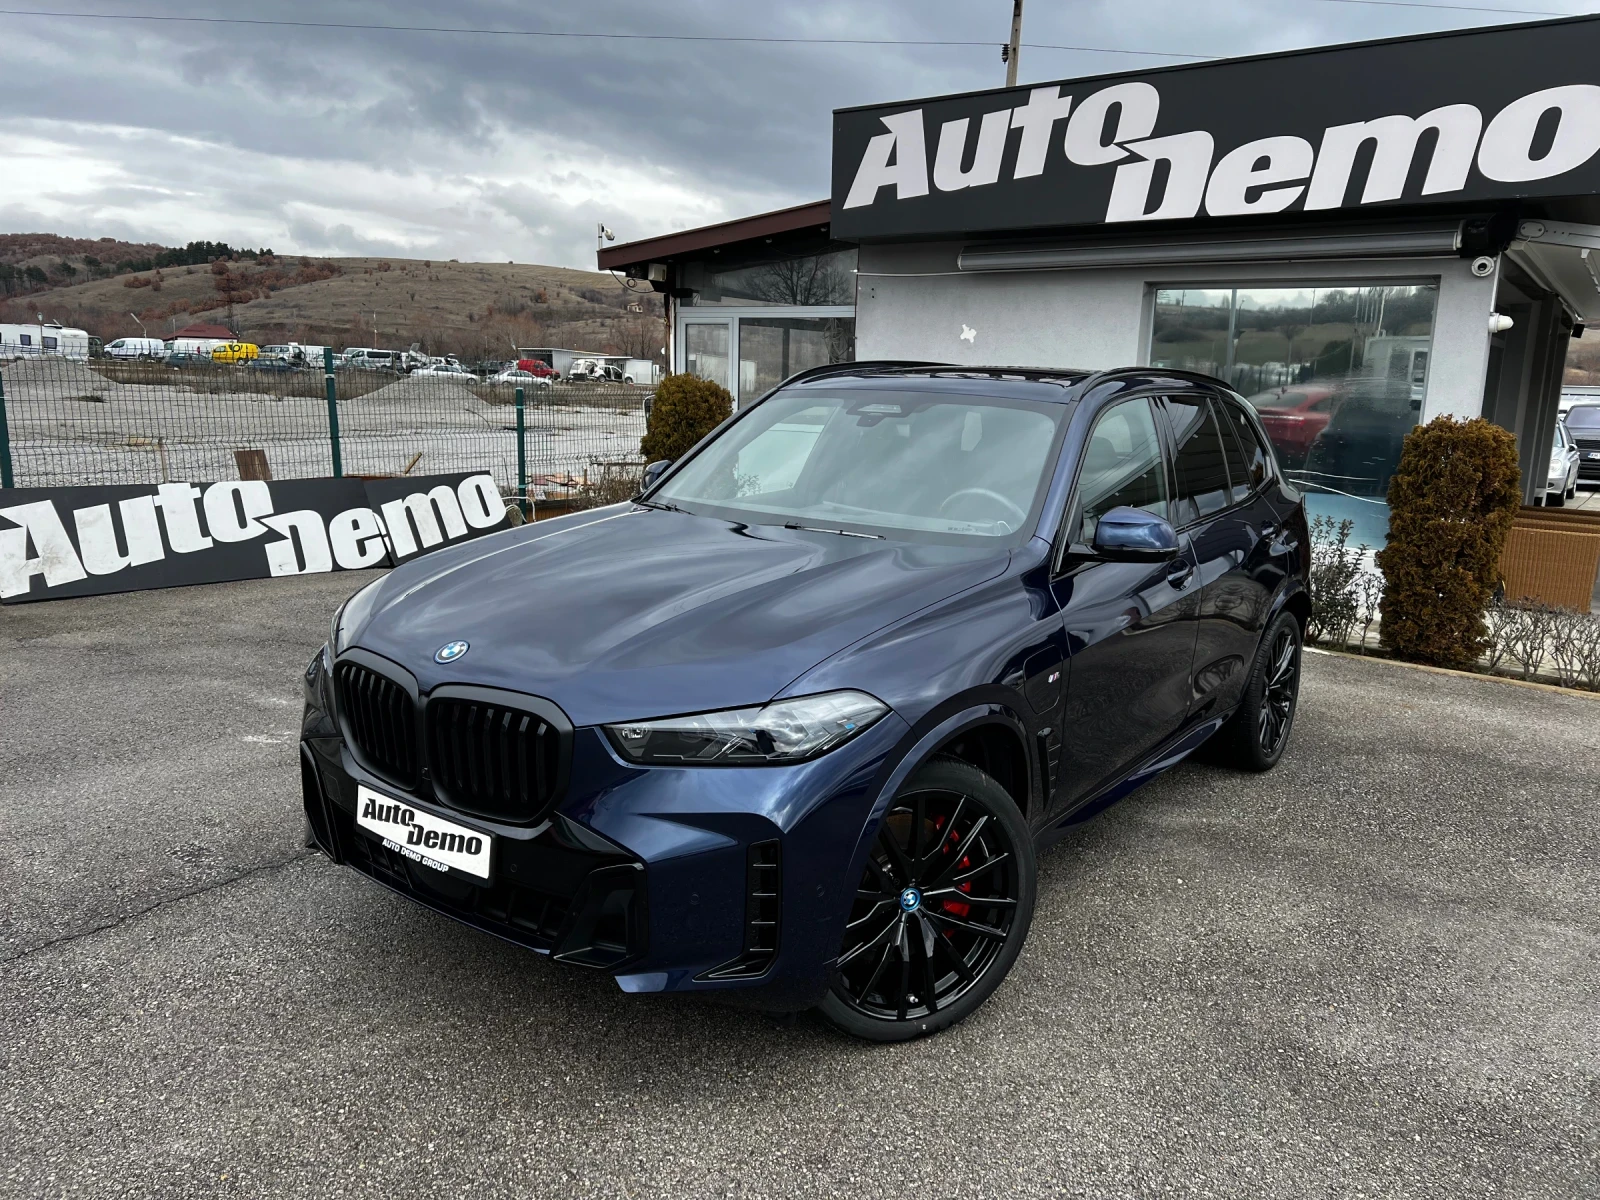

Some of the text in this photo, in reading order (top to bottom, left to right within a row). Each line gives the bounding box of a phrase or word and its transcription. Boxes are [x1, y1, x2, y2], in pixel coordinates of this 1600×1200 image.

[843, 82, 1600, 222] Auto Demo
[0, 474, 506, 598] Auto Demo
[362, 798, 482, 855] Auto Demo
[383, 839, 449, 872] AUTO DEMO GROUP
